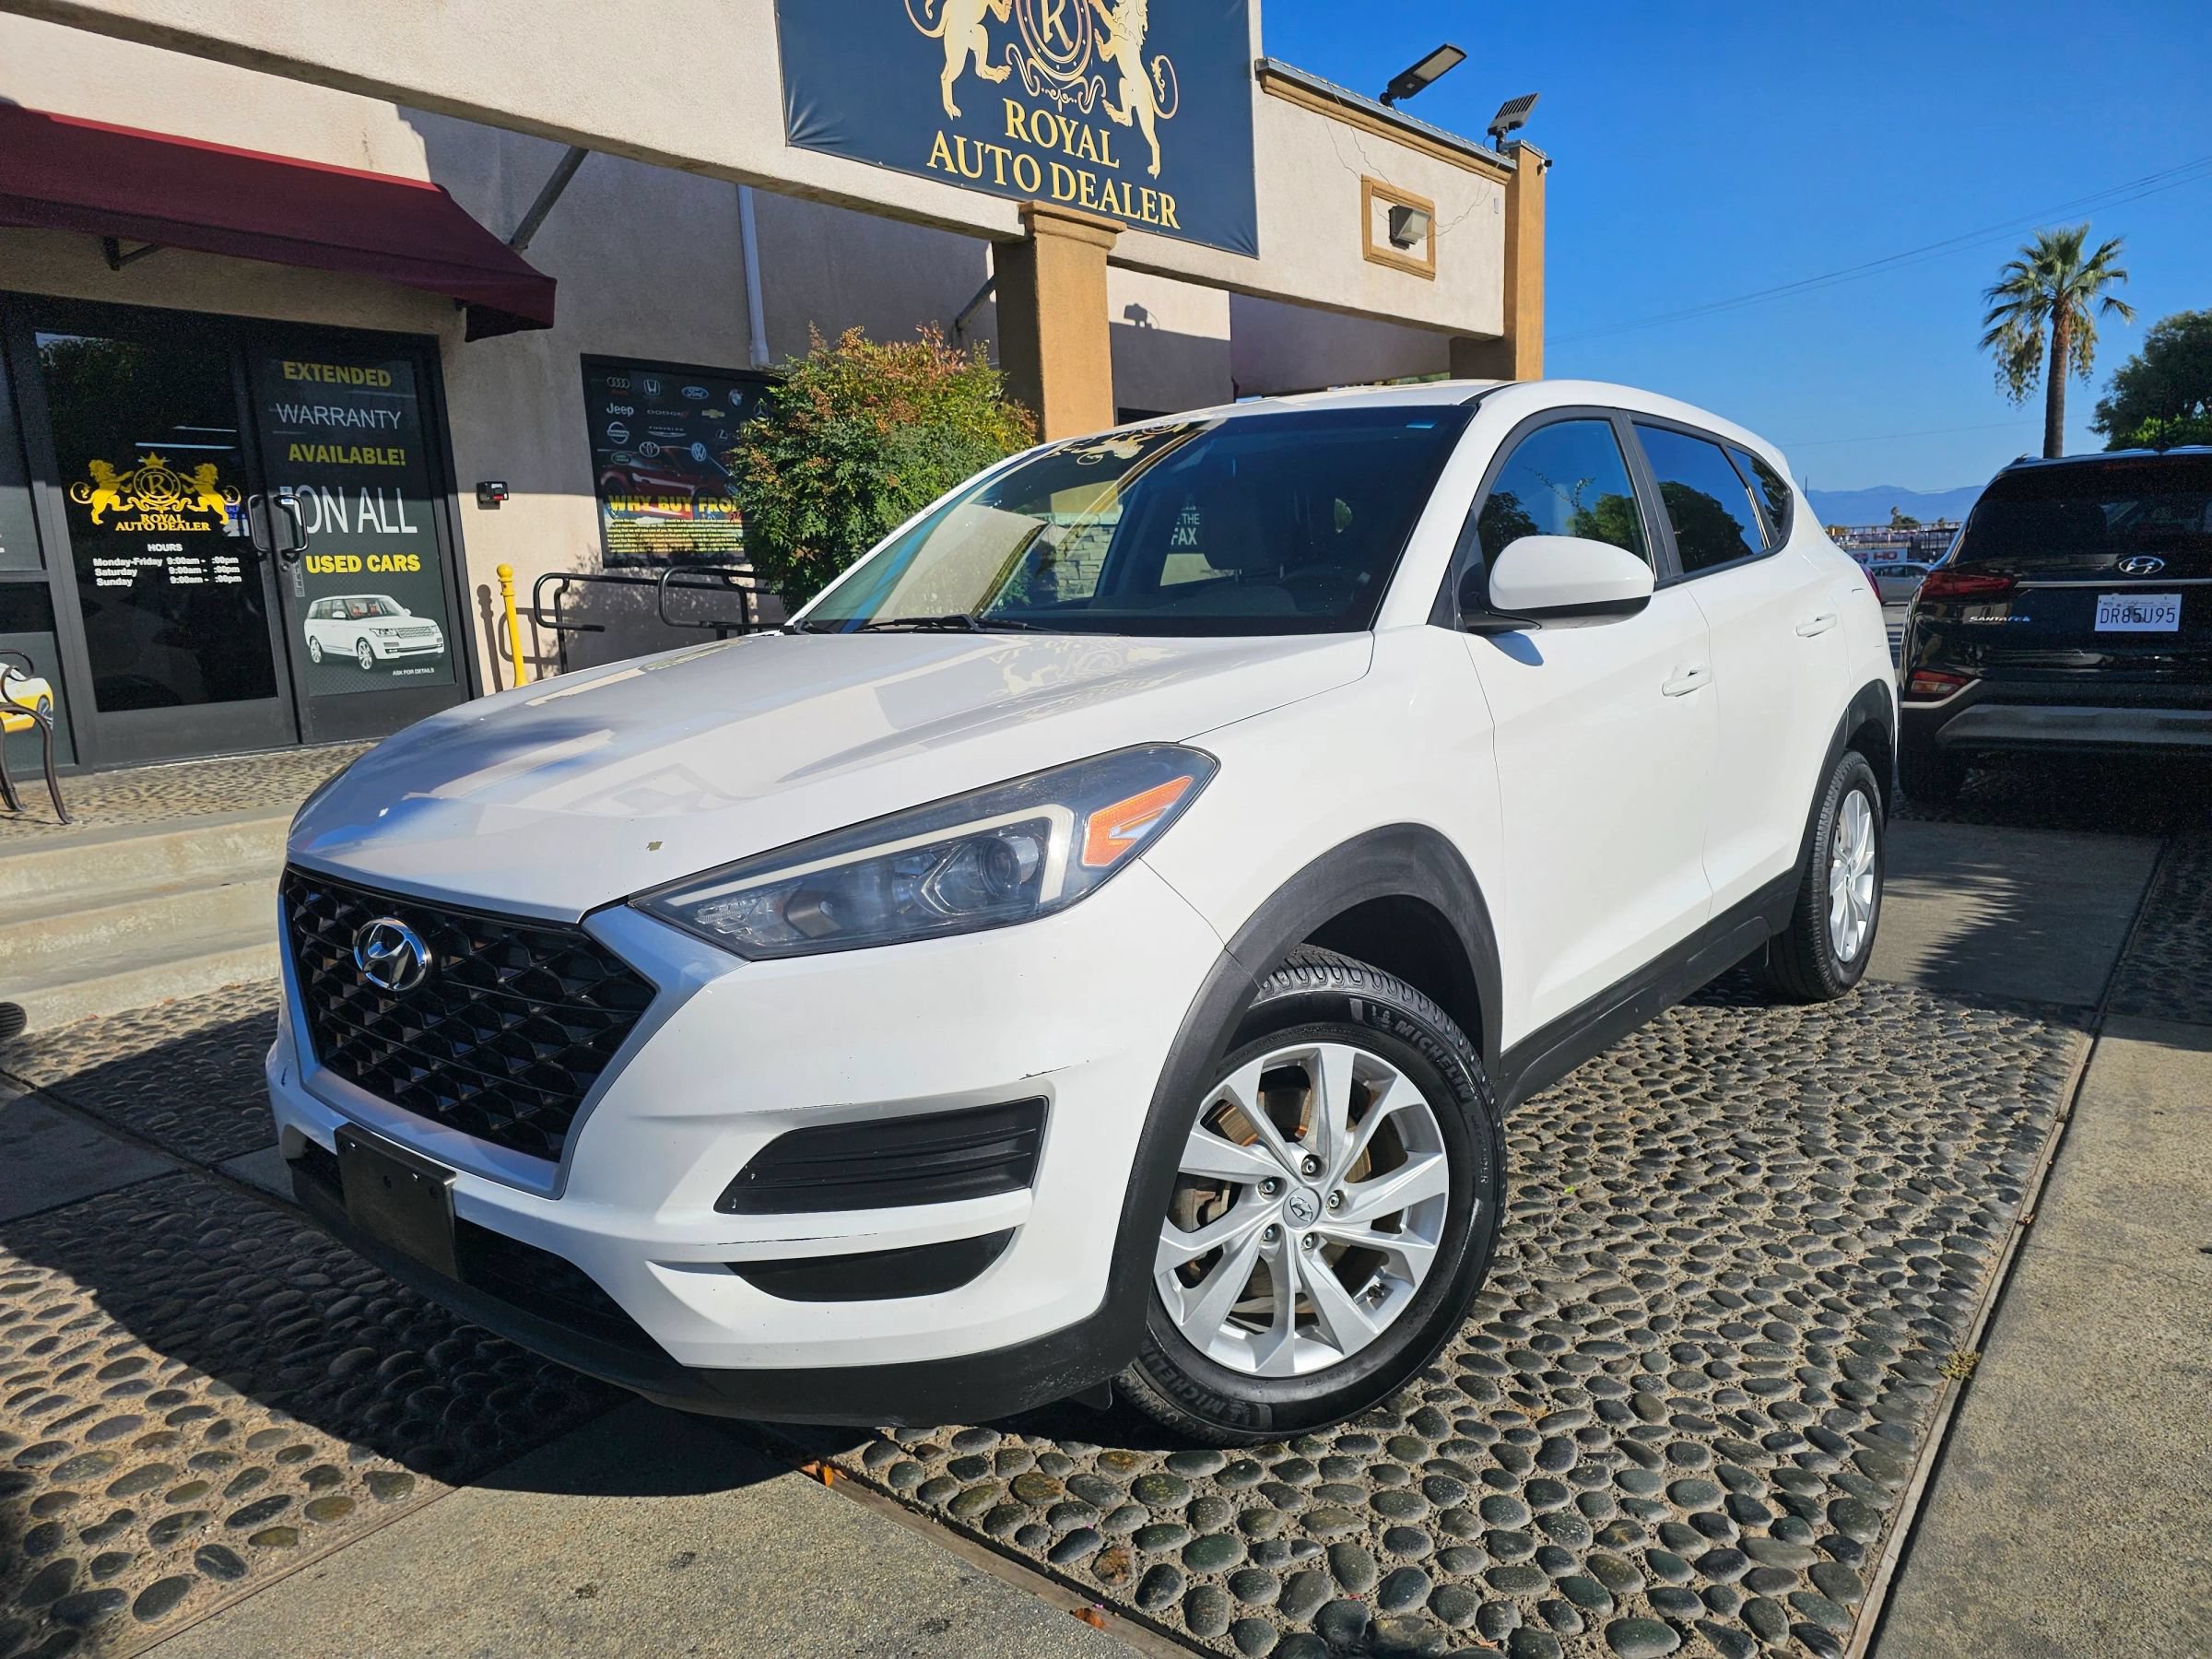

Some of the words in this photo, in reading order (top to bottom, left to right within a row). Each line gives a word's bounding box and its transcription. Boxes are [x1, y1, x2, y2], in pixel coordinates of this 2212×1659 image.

[1003, 98, 1120, 169] ROYAL
[926, 130, 1042, 193] AUTO
[1049, 162, 1181, 229] DEALER
[283, 361, 392, 387] EXTENDED
[276, 403, 401, 429] WARRANTY
[606, 403, 634, 417] Jeep
[288, 443, 406, 466] AVAILABLE!
[294, 484, 349, 535] ON
[357, 487, 418, 534] ALL
[608, 495, 652, 512] WHY
[657, 496, 691, 512] BUY
[699, 497, 737, 512] FRO
[115, 522, 156, 531] AUTO
[158, 522, 211, 531] DEALER
[141, 513, 185, 524] ROYAL
[1182, 513, 1200, 524] THE
[147, 543, 182, 552] HOURS
[93, 558, 162, 567] Monday-Friday
[305, 555, 362, 573] USED
[367, 554, 421, 572] CARS
[95, 568, 137, 577] Saturday
[96, 578, 133, 587] Sunday
[2100, 607, 2176, 624] DR85U95
[1394, 1019, 1477, 1103] MICHELIN
